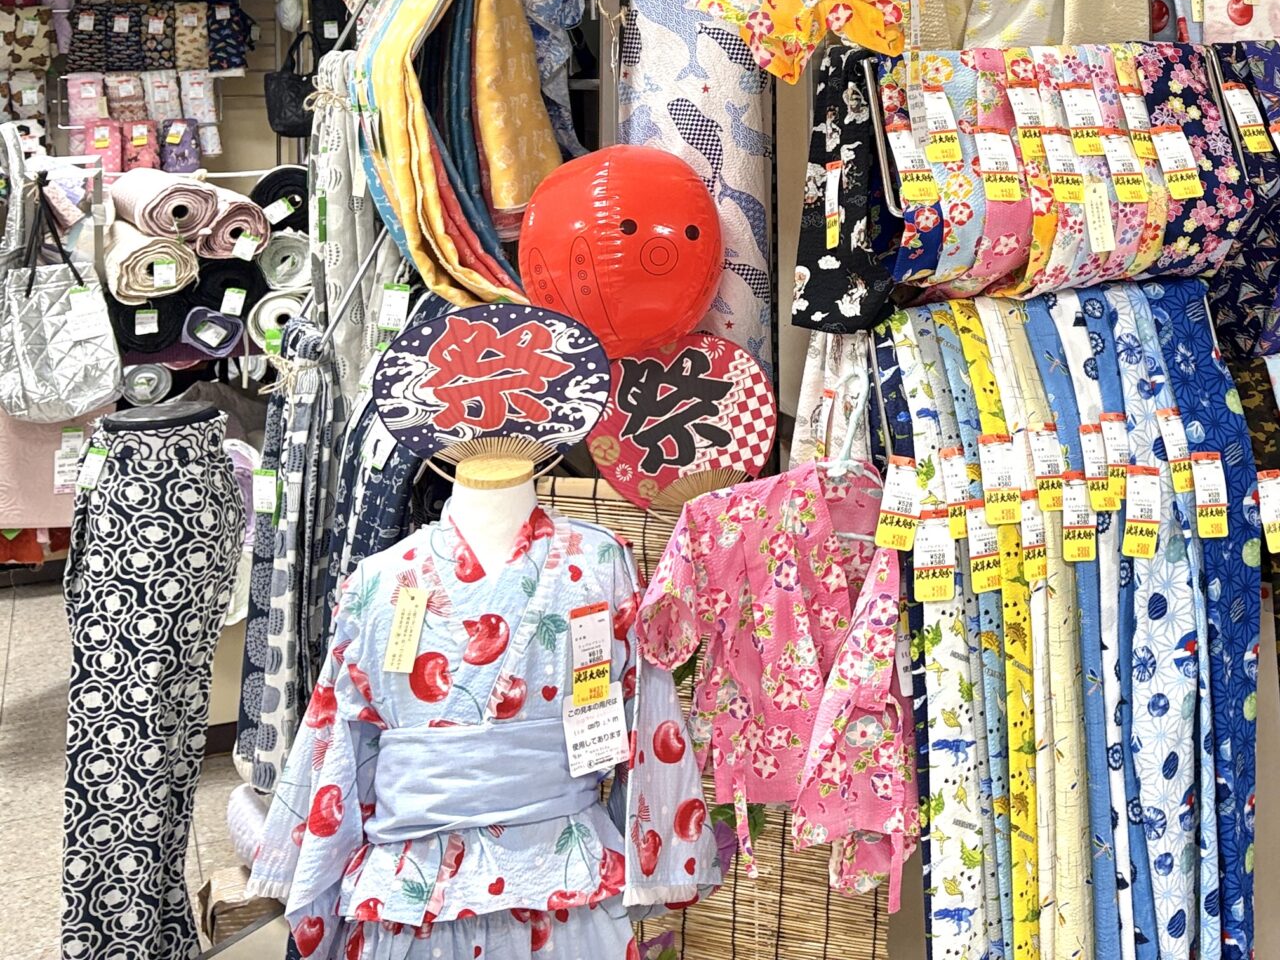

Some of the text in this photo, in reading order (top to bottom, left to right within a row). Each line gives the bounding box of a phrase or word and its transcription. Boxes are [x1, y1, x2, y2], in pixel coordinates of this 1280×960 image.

[420, 316, 576, 431] 祭
[572, 729, 622, 751] 使用してあります
